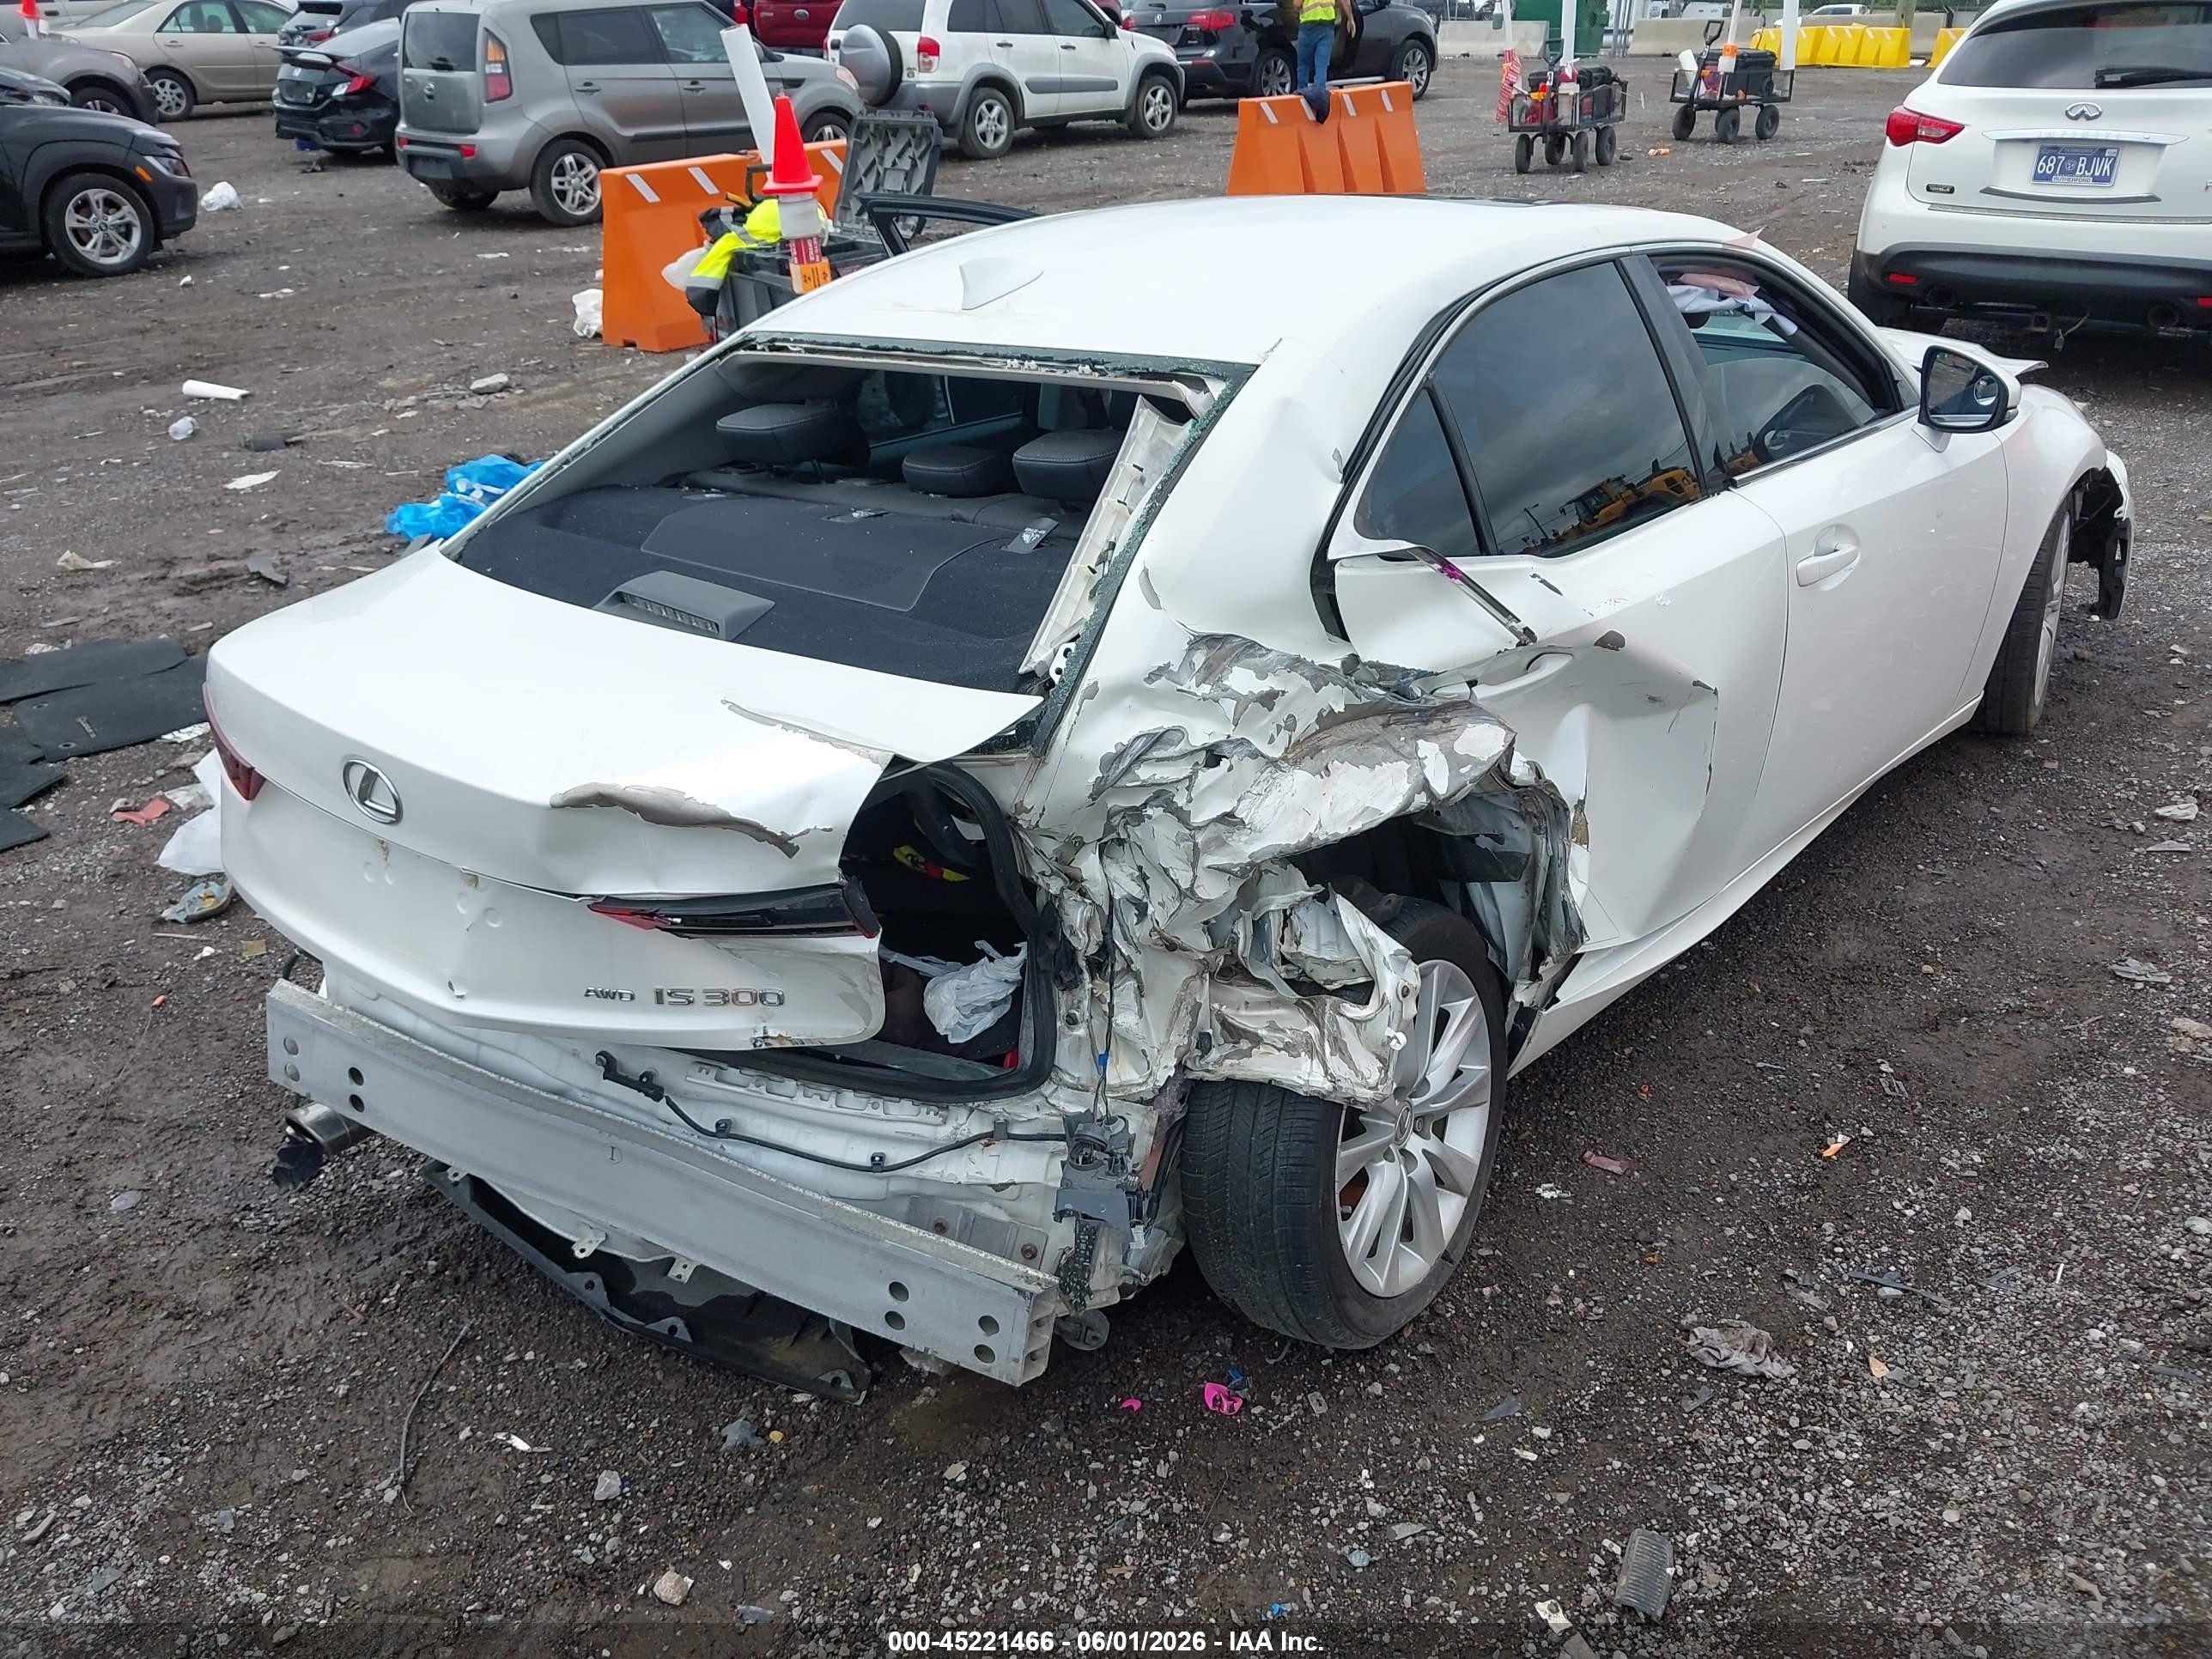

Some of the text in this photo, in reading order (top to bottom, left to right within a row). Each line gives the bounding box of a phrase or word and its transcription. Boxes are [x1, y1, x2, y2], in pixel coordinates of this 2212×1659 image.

[2037, 155, 2114, 176] 687 BJVK
[584, 986, 785, 1007] AWD IS 300
